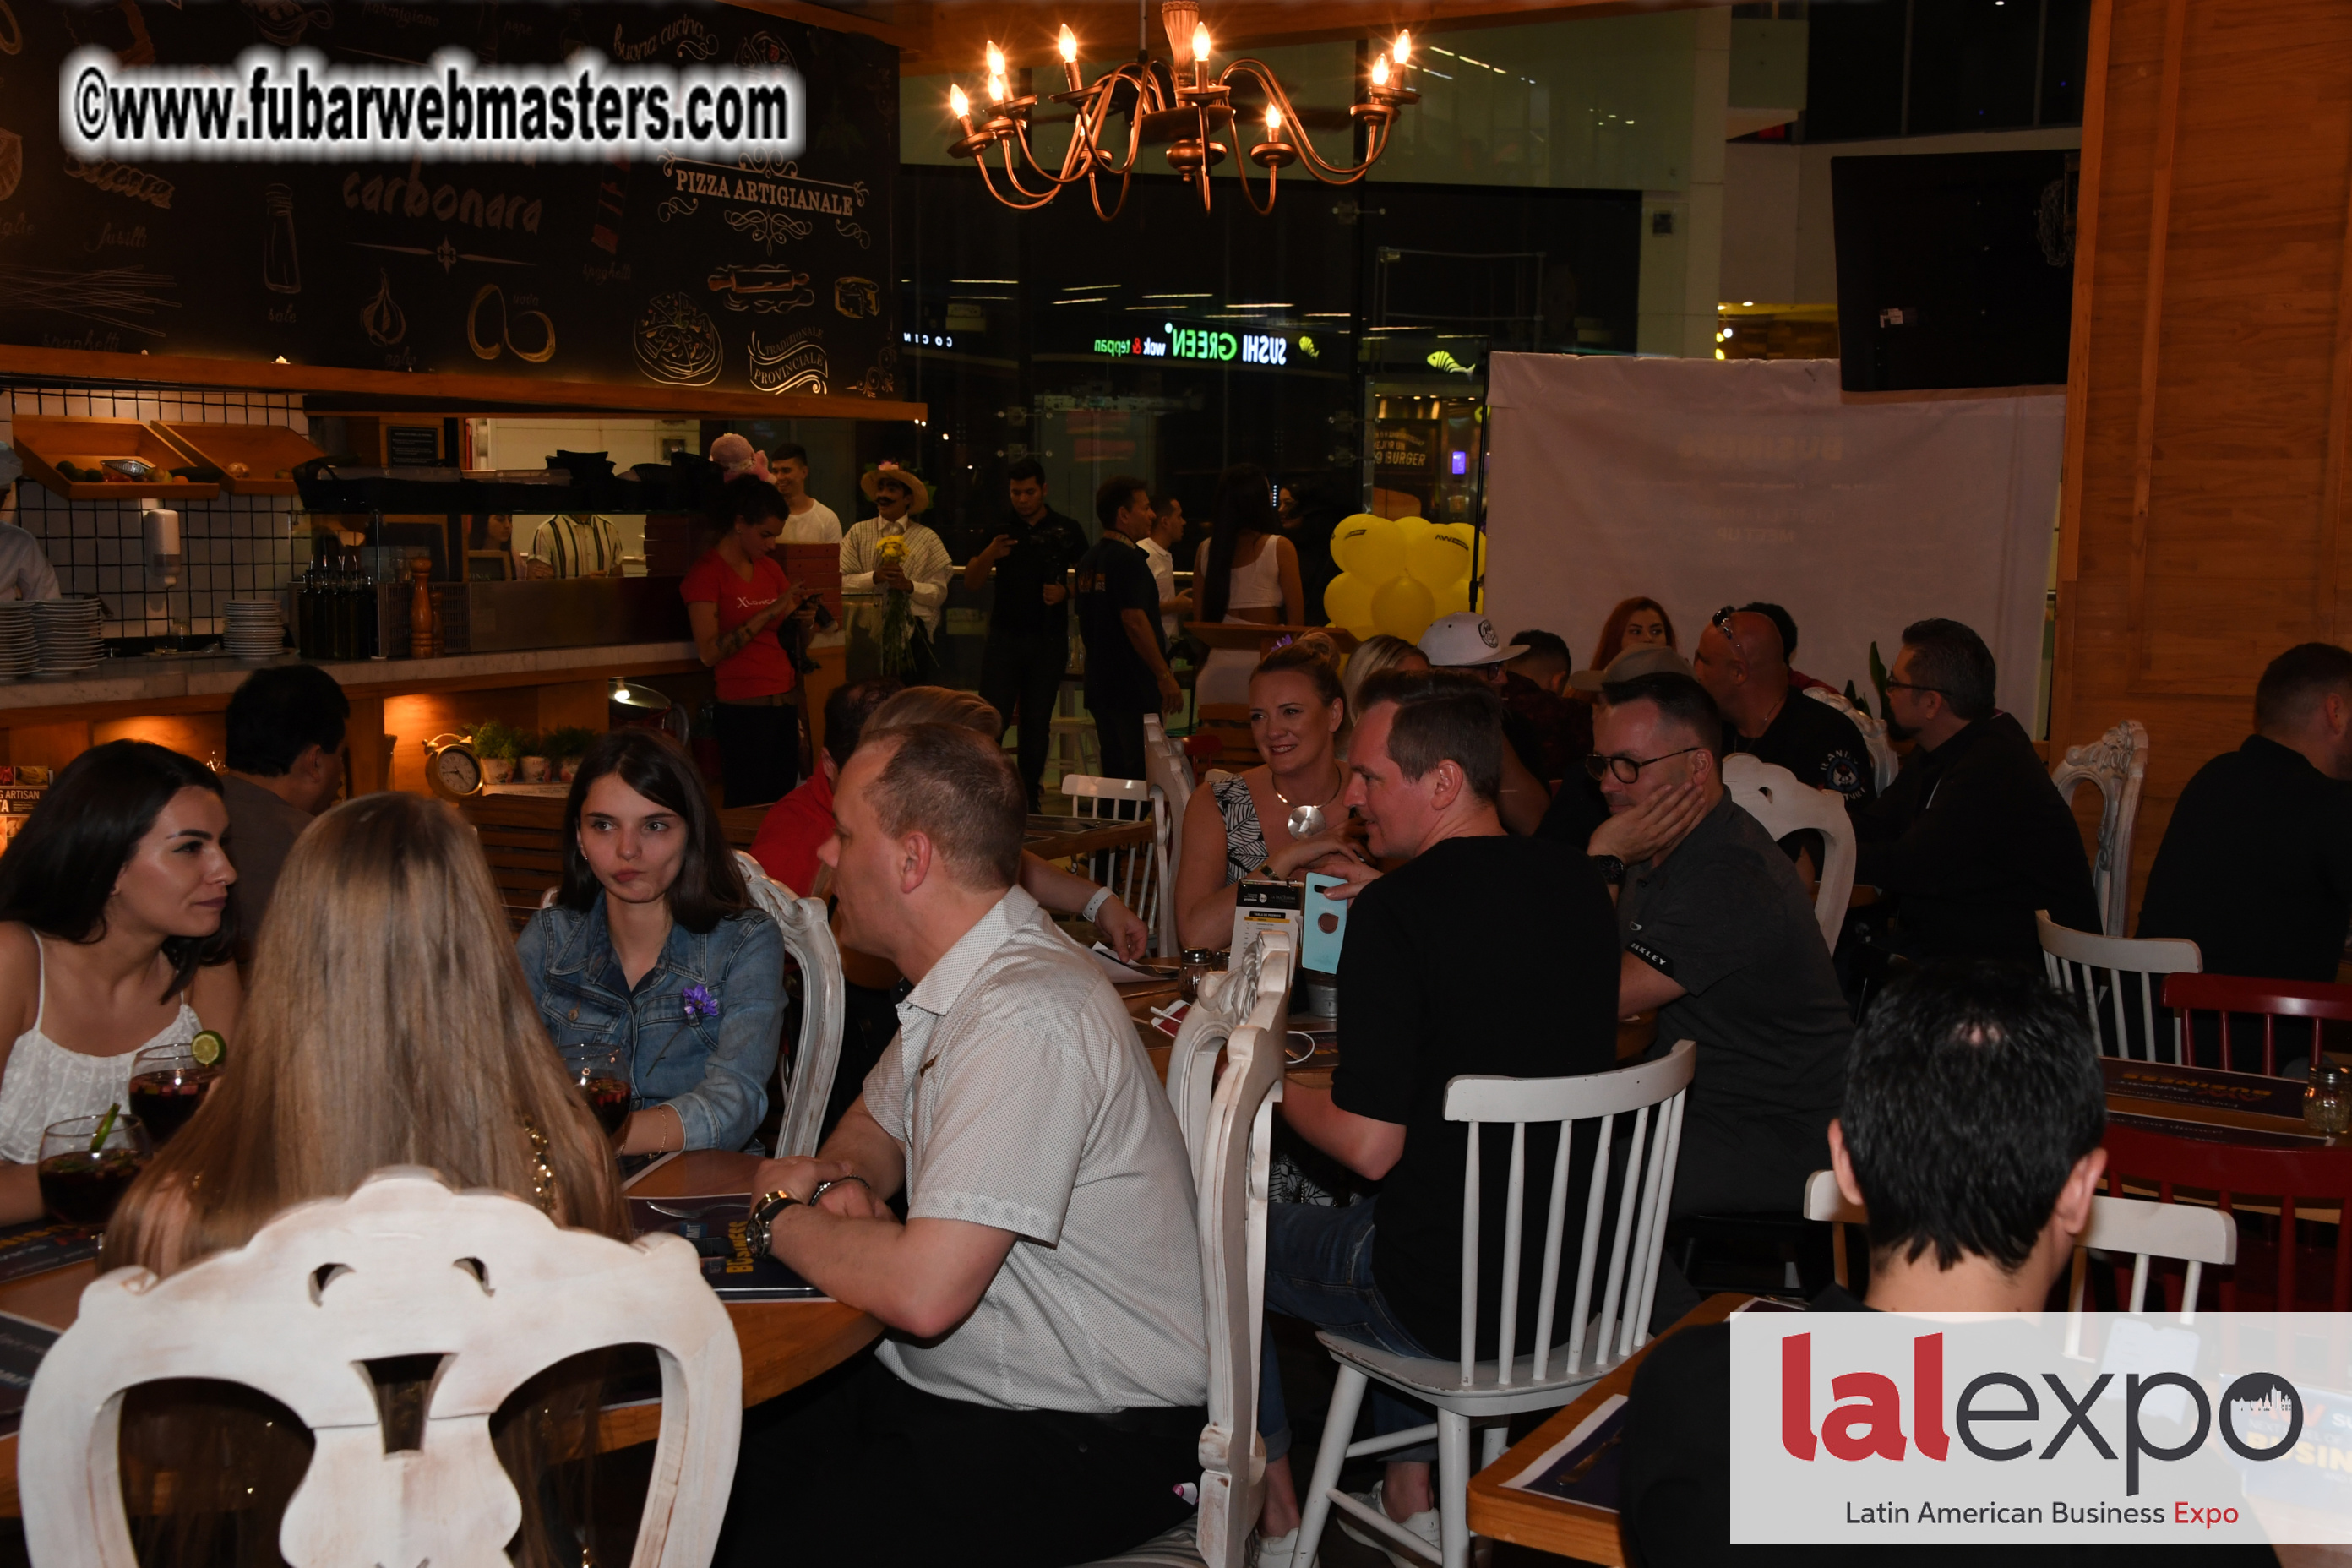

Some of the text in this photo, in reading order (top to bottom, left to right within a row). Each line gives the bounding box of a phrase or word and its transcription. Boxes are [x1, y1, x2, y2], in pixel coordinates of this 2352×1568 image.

[613, 13, 705, 62] buona cucina
[341, 152, 543, 236] carbonara
[676, 169, 853, 217] PIZZA ARTIGIANALE
[84, 221, 148, 253] fusilli
[268, 302, 297, 324] sale
[764, 324, 825, 357] TRADIZIONALE
[754, 354, 825, 385] PROVINCIALE
[1385, 451, 1426, 466] BURGER
[5, 790, 40, 800] ARTISAN
